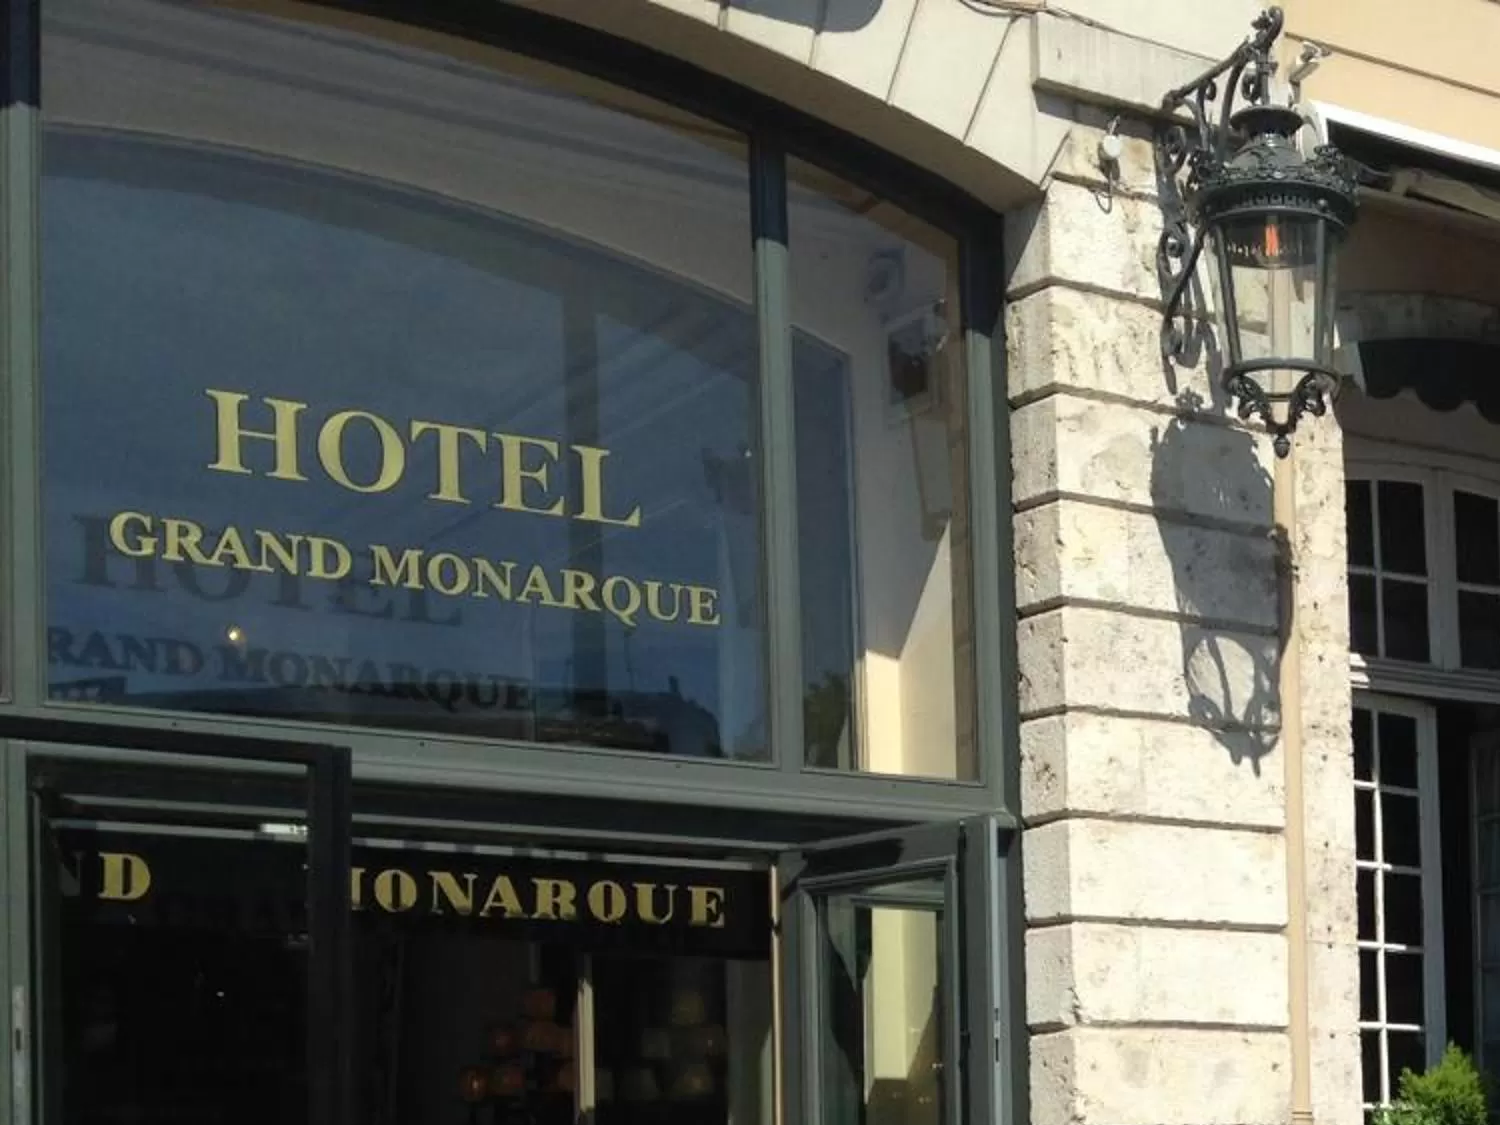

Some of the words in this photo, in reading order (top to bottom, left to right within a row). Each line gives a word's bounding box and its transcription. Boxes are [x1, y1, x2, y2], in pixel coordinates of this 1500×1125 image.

[206, 388, 642, 528] HOTEL
[109, 511, 352, 580] GRAND
[369, 544, 721, 627] MONARQUE
